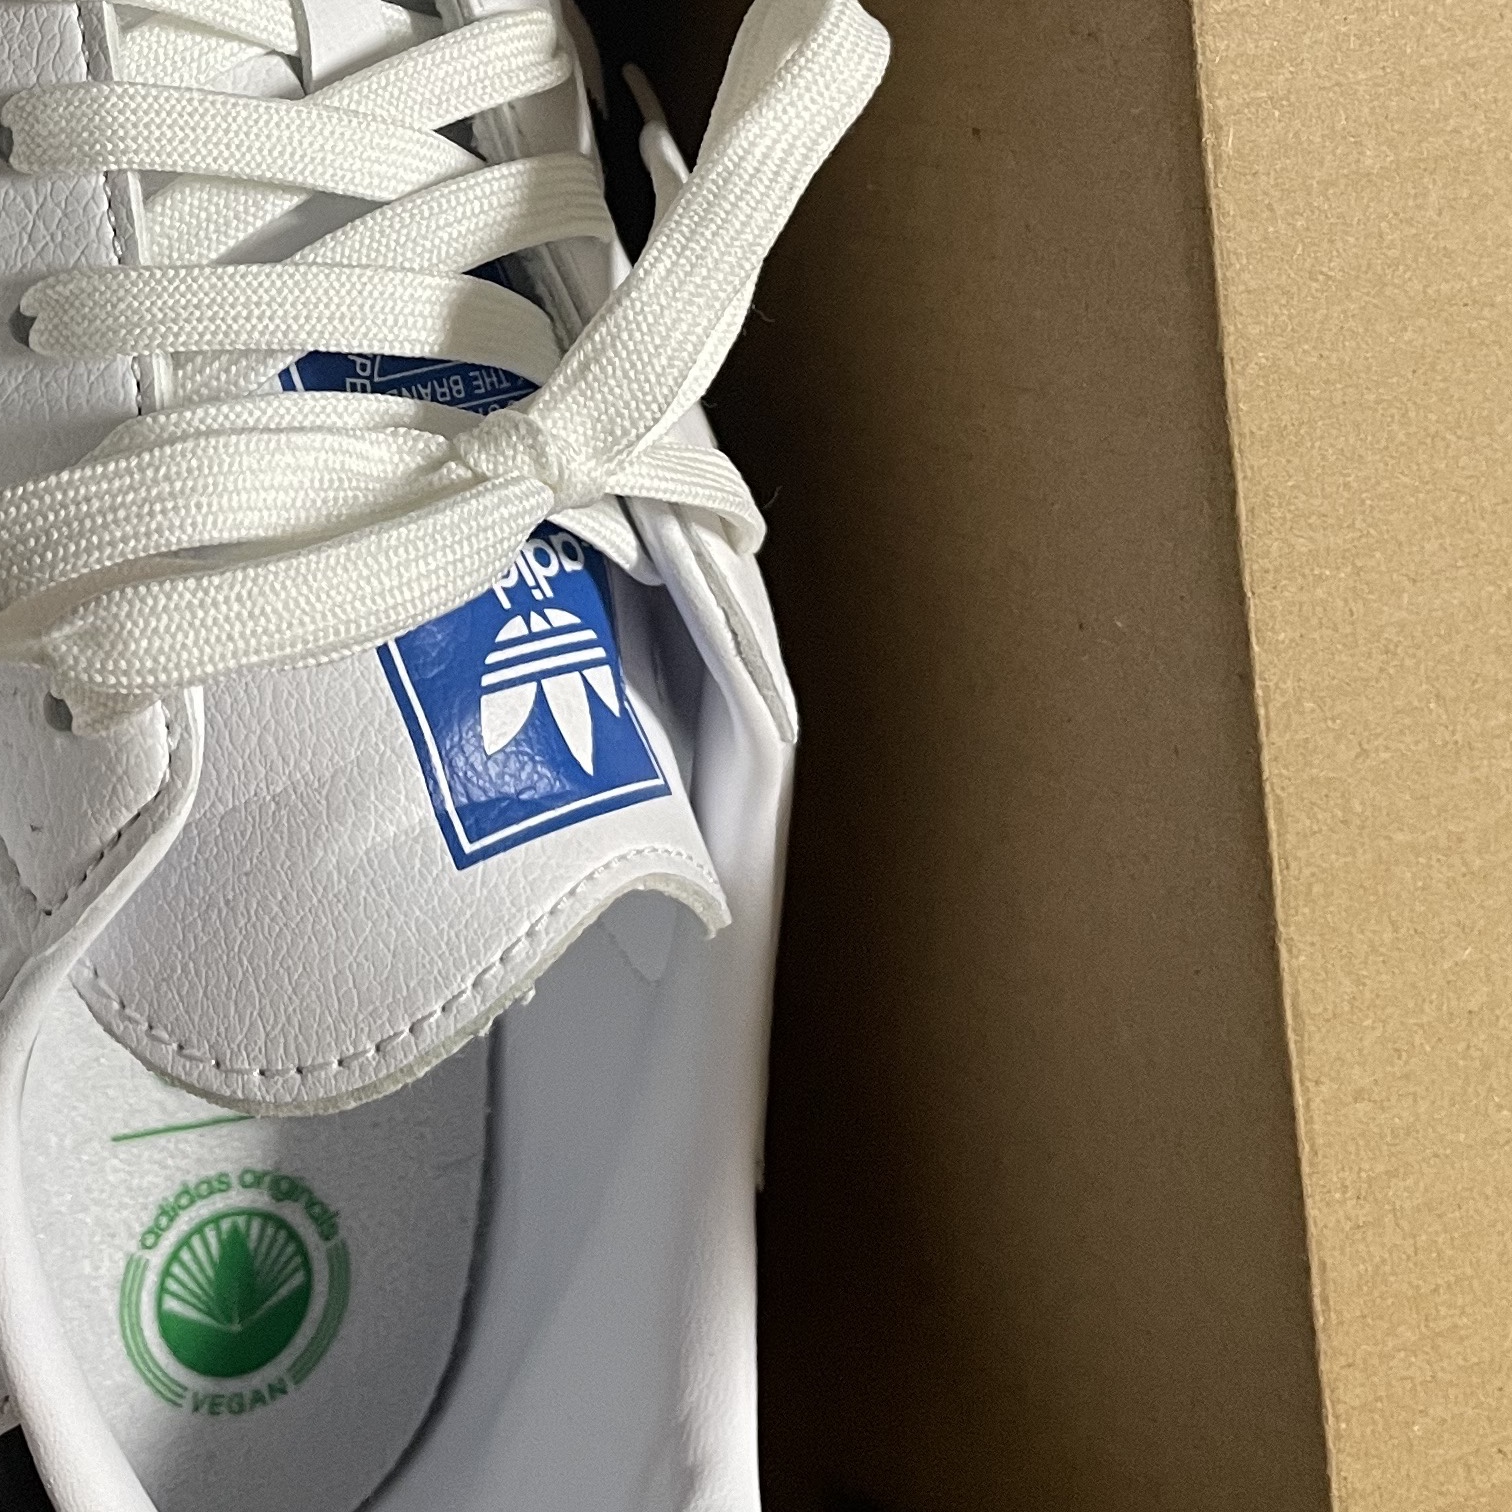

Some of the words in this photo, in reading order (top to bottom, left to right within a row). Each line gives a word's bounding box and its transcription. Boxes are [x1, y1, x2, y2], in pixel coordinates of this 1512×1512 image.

[385, 374, 465, 402] BRAN
[140, 1171, 232, 1251] adidas
[190, 1377, 289, 1416] VEGAN
